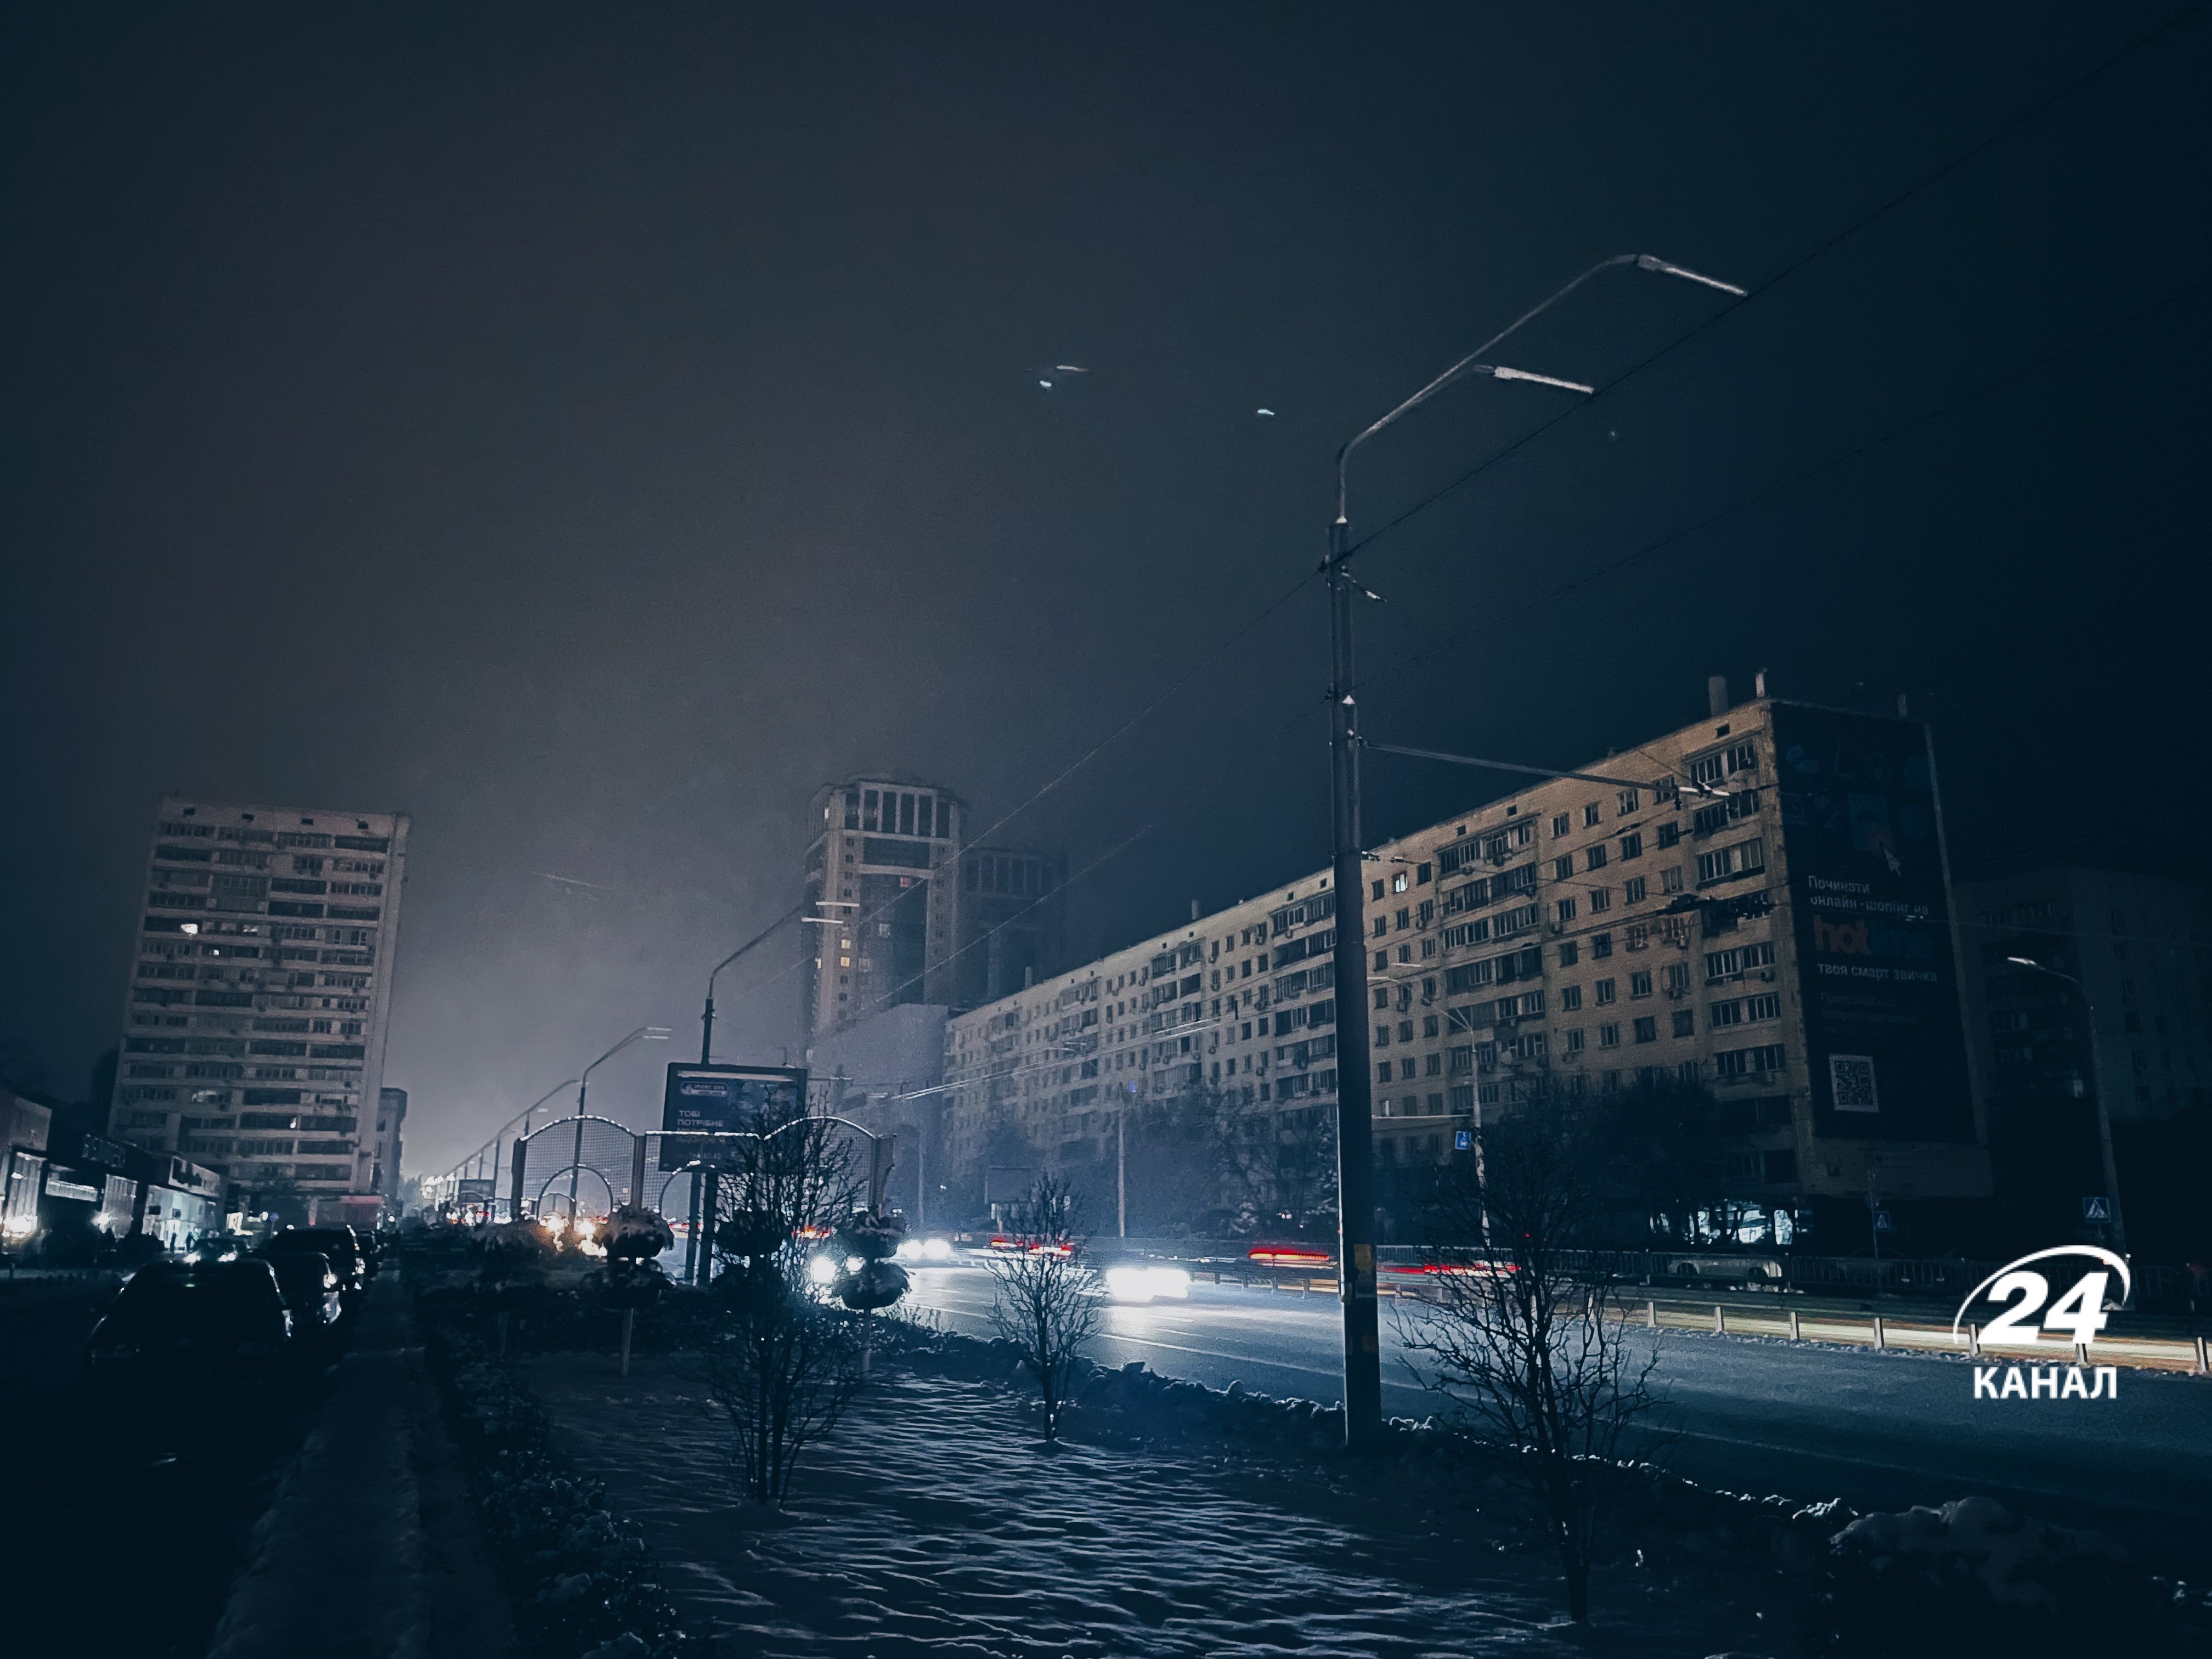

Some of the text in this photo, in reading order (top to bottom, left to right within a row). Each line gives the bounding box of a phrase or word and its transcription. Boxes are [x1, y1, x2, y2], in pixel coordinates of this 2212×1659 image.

[1808, 875, 1869, 894] Починати
[1818, 963, 1937, 982] твоя смарт звичка
[677, 1119, 725, 1127] ПОТРІБНЕ
